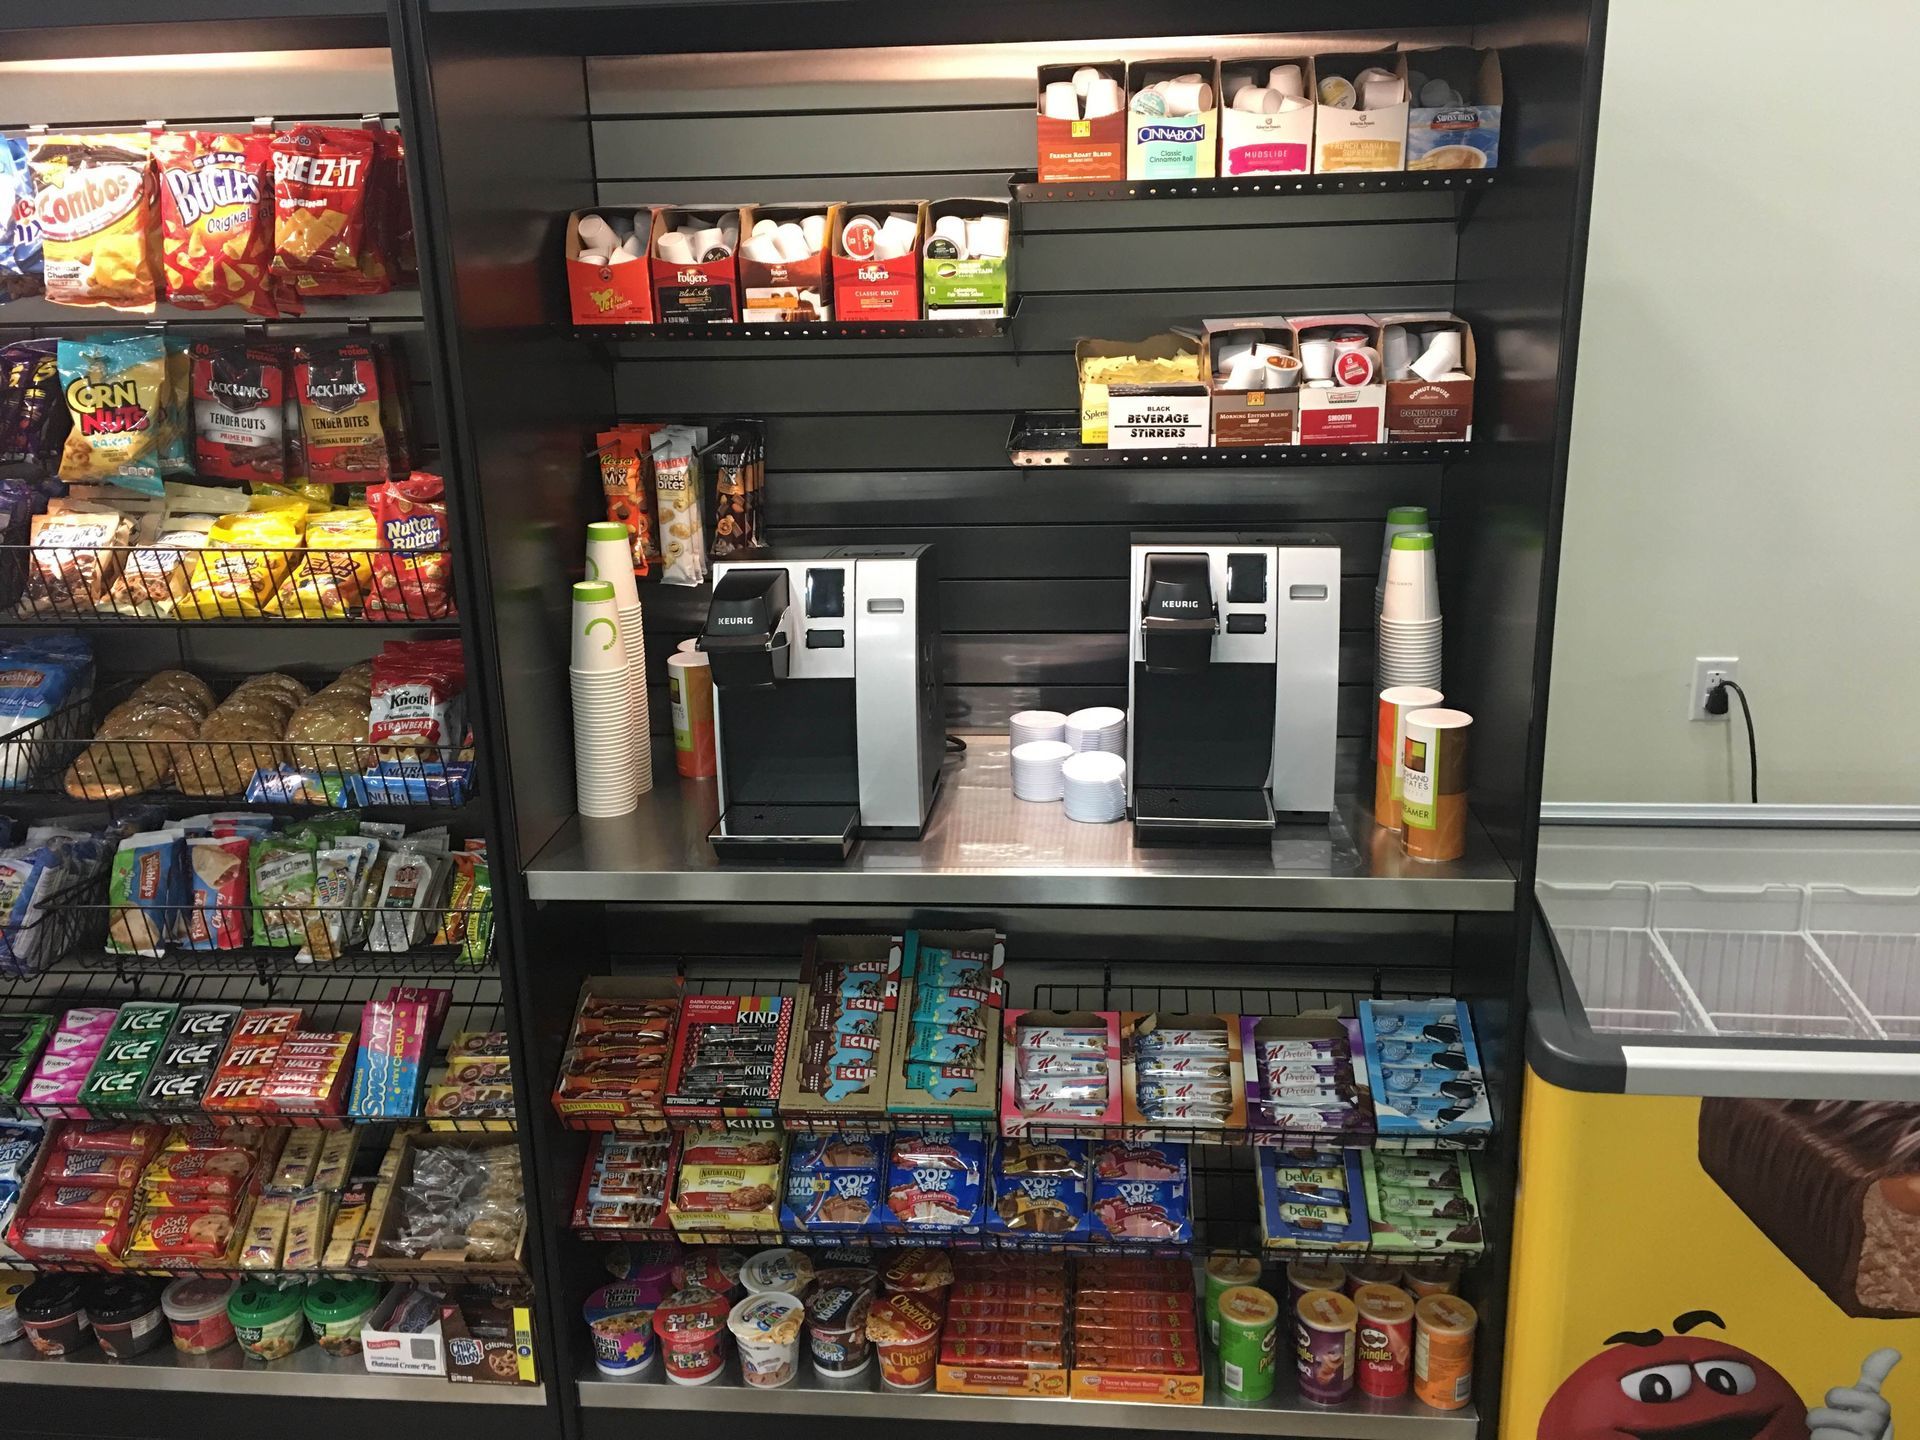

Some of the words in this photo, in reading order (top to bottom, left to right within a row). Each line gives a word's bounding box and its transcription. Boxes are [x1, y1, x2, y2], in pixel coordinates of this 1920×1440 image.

[1139, 124, 1204, 142] CINNABON
[215, 152, 245, 164] BAG
[1245, 150, 1287, 158] MUDSLIDE
[36, 173, 130, 225] Combos
[164, 167, 261, 228] BUGLES
[677, 272, 708, 284] Folgers
[858, 269, 888, 282] Folgers
[66, 376, 138, 414] CORN
[207, 380, 234, 394] JACK
[233, 383, 270, 400] LINK'S
[306, 384, 333, 397] JACK
[333, 383, 366, 396] LINK'S
[1409, 386, 1430, 399] DONUT
[1430, 385, 1450, 399] HOUSE
[1083, 409, 1108, 420] Splen
[1128, 413, 1189, 423] BEVERAGE
[1401, 409, 1428, 417] DONUT
[1429, 408, 1457, 416] HOUSE
[80, 405, 150, 436] NUTS
[210, 412, 241, 428] TENDER
[241, 416, 266, 430] CUTS
[312, 417, 343, 430] TENDER
[343, 416, 370, 428] BITES
[220, 432, 240, 441] PRIME
[240, 434, 254, 443] RIB
[1131, 428, 1185, 438] STIRRERS
[600, 454, 634, 466] Reese's
[655, 457, 689, 469] PAYDAY
[604, 474, 627, 486] MIX
[658, 473, 684, 481] snack
[658, 479, 685, 491] bites
[387, 517, 436, 540] Nutter
[391, 530, 442, 550] Butter
[1161, 600, 1199, 608] KEURIG
[718, 617, 753, 625] KEURIG
[390, 691, 429, 709] Knott's
[377, 719, 434, 732] STRAWBERRY
[260, 866, 283, 881] Bear
[284, 858, 310, 874] Claw
[962, 951, 991, 961] CLIF
[858, 962, 887, 973] CLIF
[957, 989, 989, 1002] CLIF
[855, 999, 884, 1012] CLIF
[69, 1014, 94, 1024] Trident
[121, 1010, 171, 1031] ICE
[180, 1013, 231, 1033] ICE
[737, 1011, 779, 1024] KIND
[240, 1015, 294, 1035] FIRE
[298, 1032, 335, 1041] HALLS
[956, 1027, 987, 1040] CLIF
[1030, 1030, 1049, 1048] K
[1173, 1031, 1191, 1045] K
[56, 1036, 83, 1046] Trident
[850, 1036, 880, 1050] CLIF
[106, 1040, 157, 1061] ICE
[166, 1044, 217, 1065] ICE
[225, 1045, 279, 1066] FIRE
[290, 1045, 326, 1054] HALLS
[1267, 1045, 1284, 1060] K
[1283, 1049, 1313, 1059] Protein
[44, 1059, 72, 1069] Trident
[285, 1059, 321, 1069] HALLS
[744, 1065, 773, 1075] KIND
[1038, 1055, 1057, 1073] K
[846, 1067, 876, 1080] CLIF
[1271, 1066, 1288, 1084] K
[1285, 1073, 1316, 1083] Protein
[33, 1082, 61, 1092] Trident
[90, 1071, 142, 1092] ICE
[150, 1075, 203, 1096] ICE
[214, 1077, 268, 1098] FIRE
[603, 1090, 623, 1098] Almond
[741, 1088, 769, 1097] KIND
[1285, 1087, 1316, 1096] Protein
[461, 1103, 494, 1111] Caramel
[588, 1102, 622, 1110] VALLEY
[1176, 1104, 1193, 1117] K
[726, 1119, 775, 1129] KIND
[1276, 1114, 1295, 1127] K
[1292, 1122, 1322, 1131] Protein
[183, 1152, 205, 1164] Soft
[1124, 1150, 1151, 1158] Cherry
[68, 1158, 104, 1173] Butter
[608, 1172, 625, 1180] BIG
[701, 1170, 722, 1178] NATURE
[722, 1169, 745, 1178] VALLEY
[1285, 1170, 1323, 1184] belVita
[789, 1177, 816, 1187] WIN
[920, 1180, 947, 1192] tarts
[788, 1187, 814, 1196] GOLD
[841, 1185, 870, 1200] tarts
[913, 1191, 952, 1201] Strawberry
[1029, 1188, 1056, 1200] tarts
[1127, 1193, 1154, 1205] tarts
[1125, 1205, 1152, 1213] Cherry
[1289, 1204, 1328, 1219] belVita
[164, 1215, 188, 1227] Soft
[154, 1224, 188, 1239] Batch
[817, 1289, 853, 1321] KRISPIES
[890, 1294, 937, 1331] Cheerios
[450, 1340, 476, 1353] Chips
[456, 1343, 484, 1365] Ahoy!
[1359, 1348, 1392, 1362] Pringles
[371, 1360, 399, 1369] Oatmeal
[400, 1362, 420, 1370] Creme
